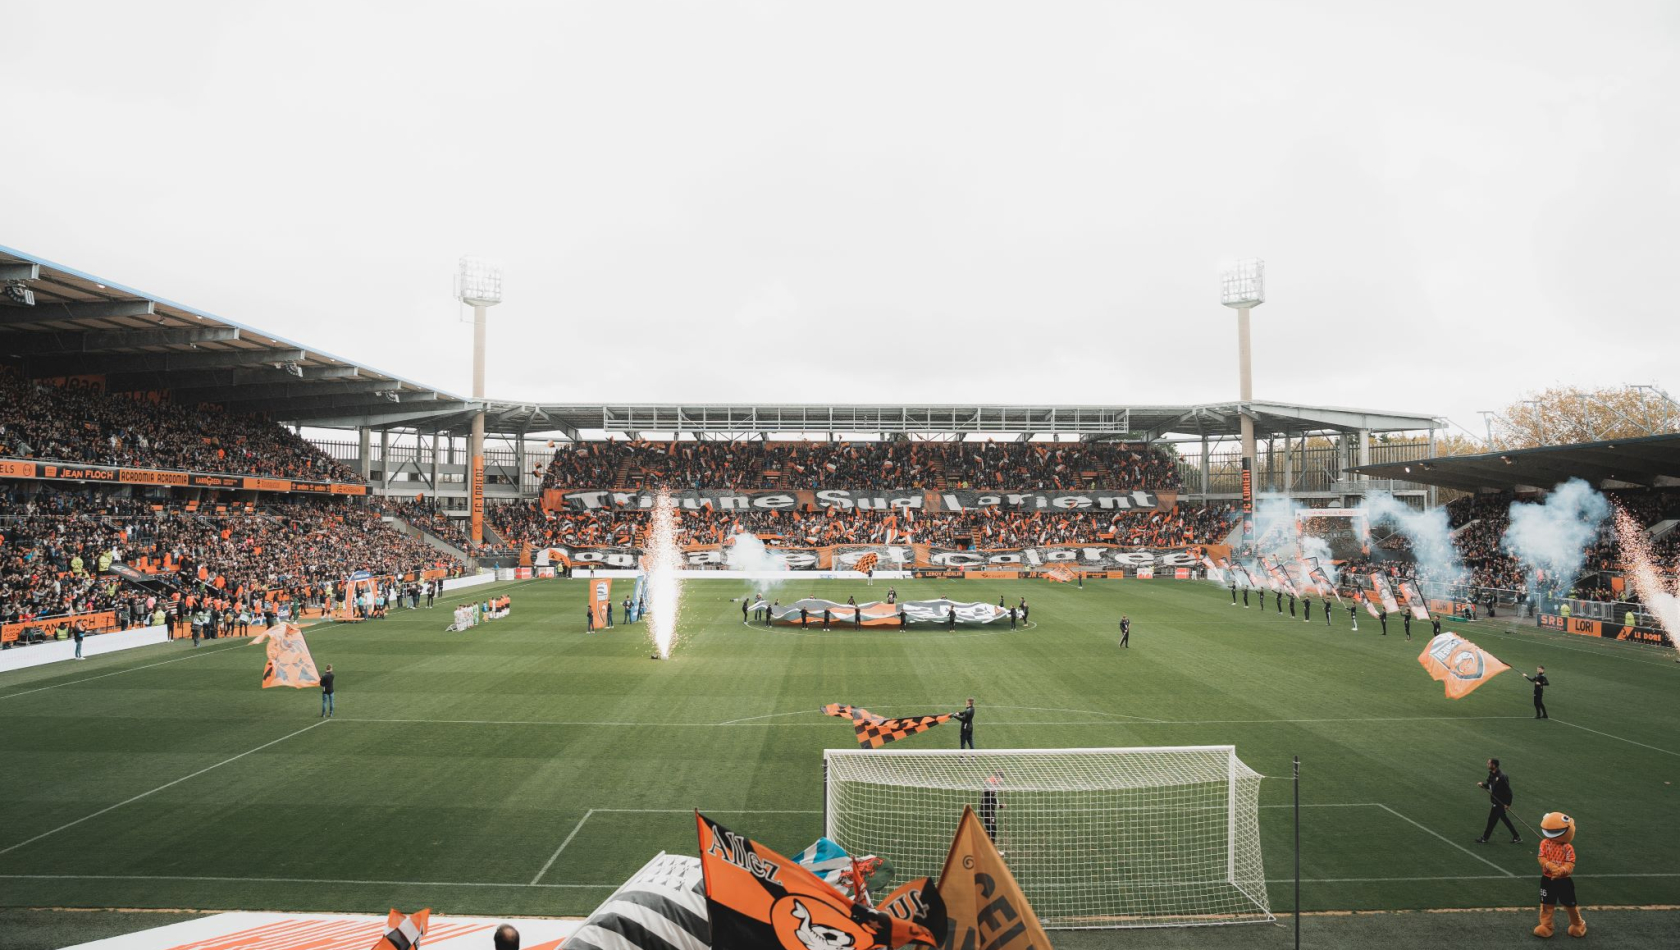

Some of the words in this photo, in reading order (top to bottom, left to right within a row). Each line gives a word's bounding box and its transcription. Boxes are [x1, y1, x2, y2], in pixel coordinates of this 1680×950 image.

[60, 468, 83, 479] JEAN
[85, 470, 113, 480] FLOCH
[121, 471, 154, 483] ACADOMIA
[158, 473, 187, 484] ACADOMIA
[1243, 469, 1251, 501] LORIENT
[942, 490, 1156, 511] Lorient
[475, 502, 482, 513] FC
[1243, 503, 1252, 513] FC
[1540, 615, 1564, 627] SRB
[1575, 619, 1594, 633] LORI
[708, 823, 783, 887] Allez
